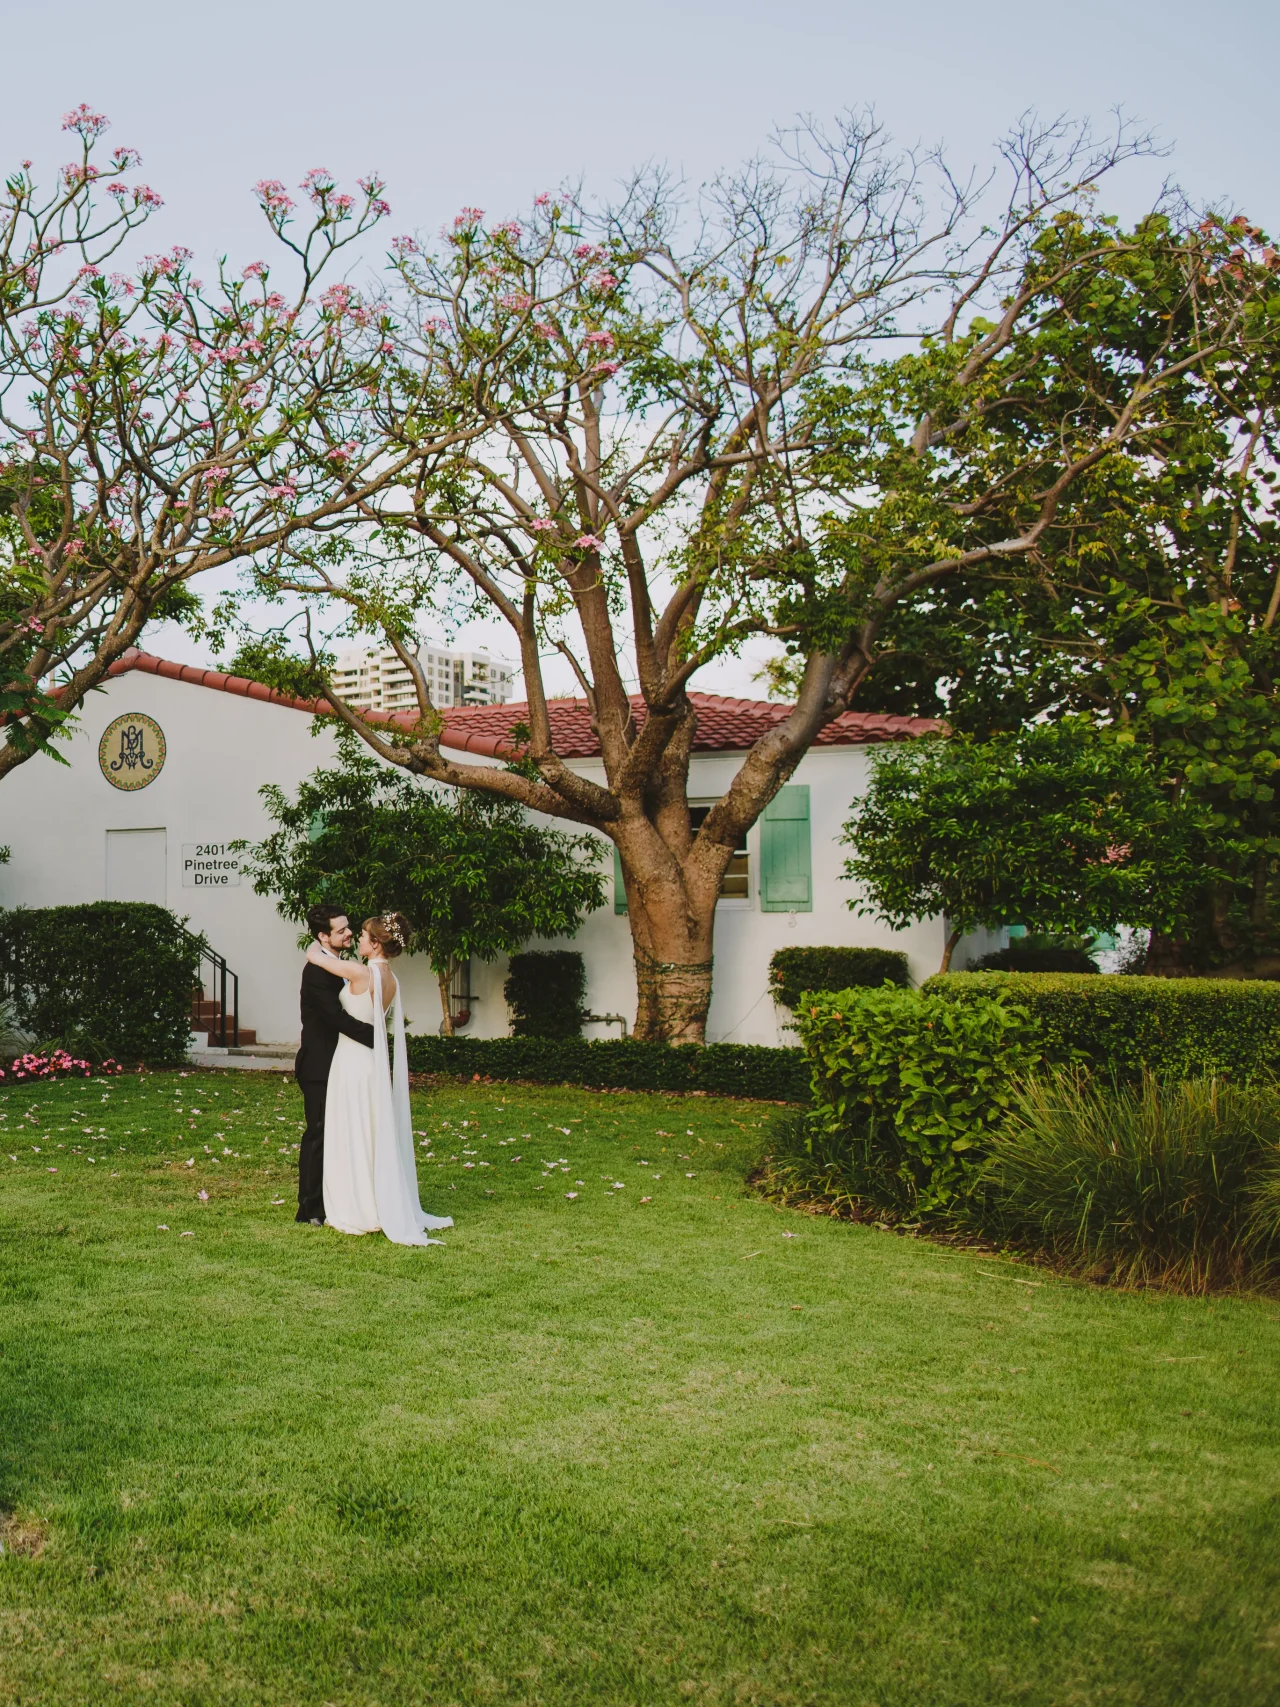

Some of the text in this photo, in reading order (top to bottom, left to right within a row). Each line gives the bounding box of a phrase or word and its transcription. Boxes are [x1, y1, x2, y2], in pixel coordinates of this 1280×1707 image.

[195, 844, 226, 856] 2401
[184, 859, 239, 871] Pinetree
[194, 873, 229, 885] Drive
